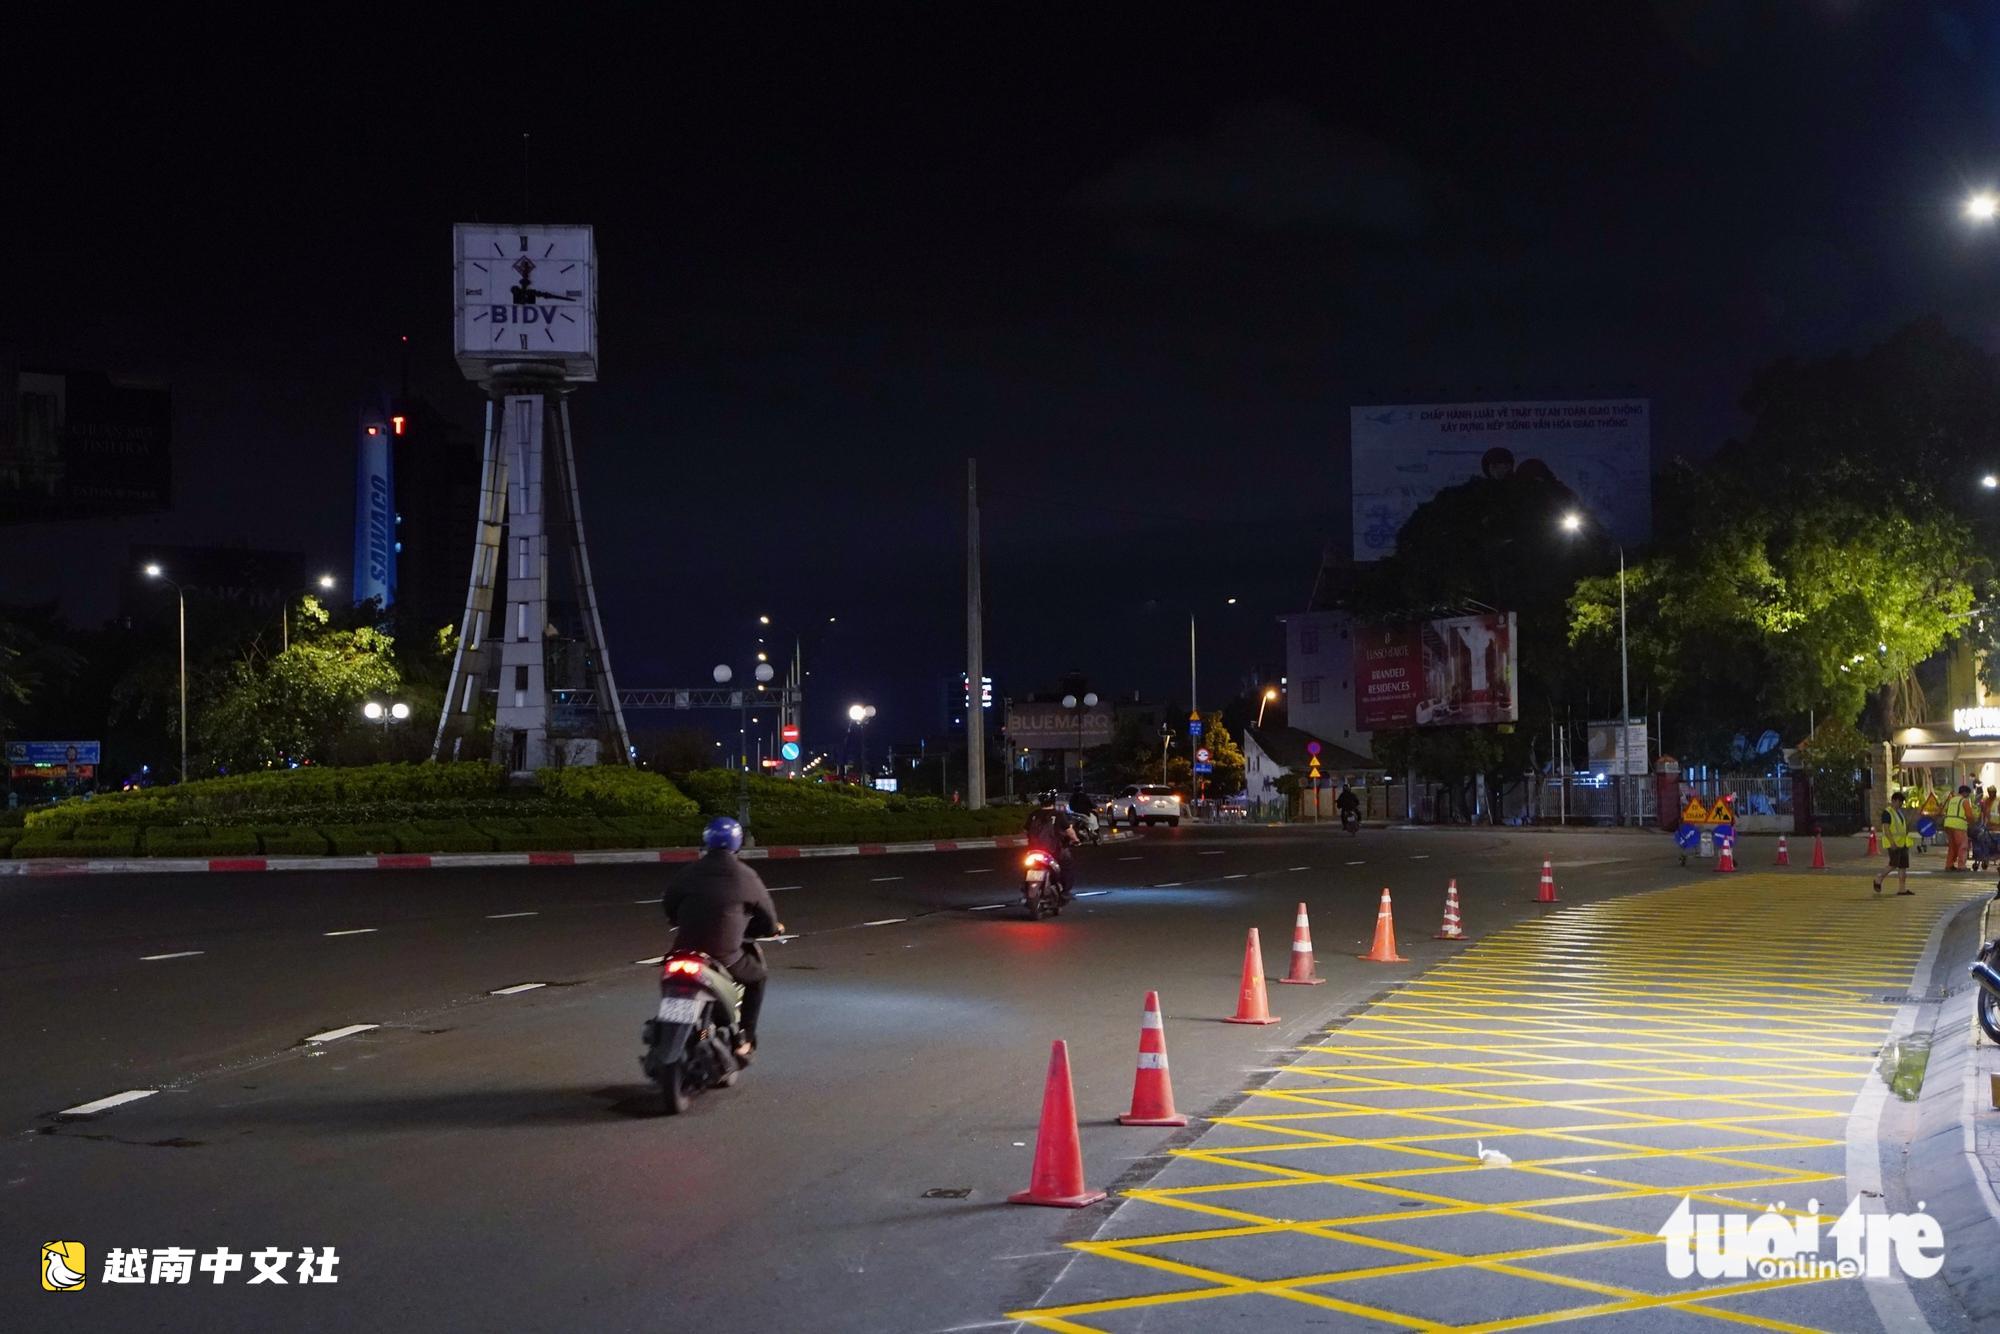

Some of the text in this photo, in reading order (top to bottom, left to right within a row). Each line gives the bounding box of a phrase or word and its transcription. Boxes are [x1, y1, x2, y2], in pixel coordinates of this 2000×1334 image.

[491, 305, 557, 325] BIDV
[1420, 407, 1444, 420] CHẤP
[1446, 406, 1472, 419] HÀNH
[1474, 406, 1495, 419] LUẬT
[1496, 404, 1508, 418] VỀ
[1510, 406, 1532, 418] TRẬT
[1548, 407, 1560, 417] AN
[1562, 405, 1586, 416] TOÀN
[1588, 405, 1610, 415] GIAO
[1612, 403, 1643, 415] THÔNG
[1441, 420, 1458, 432] XÂY
[1459, 421, 1485, 433] DỰNG
[1487, 419, 1504, 431] NẾP
[1506, 418, 1532, 430] SỐNG
[1534, 417, 1551, 429] VĂN
[1573, 418, 1595, 429] GIAO
[1597, 416, 1628, 428] THÔNG
[370, 474, 387, 584] SAWACO
[1371, 667, 1406, 680] BRANDED
[1368, 681, 1411, 694] RESIDENCES
[1011, 713, 1109, 730] BLUEMARQ
